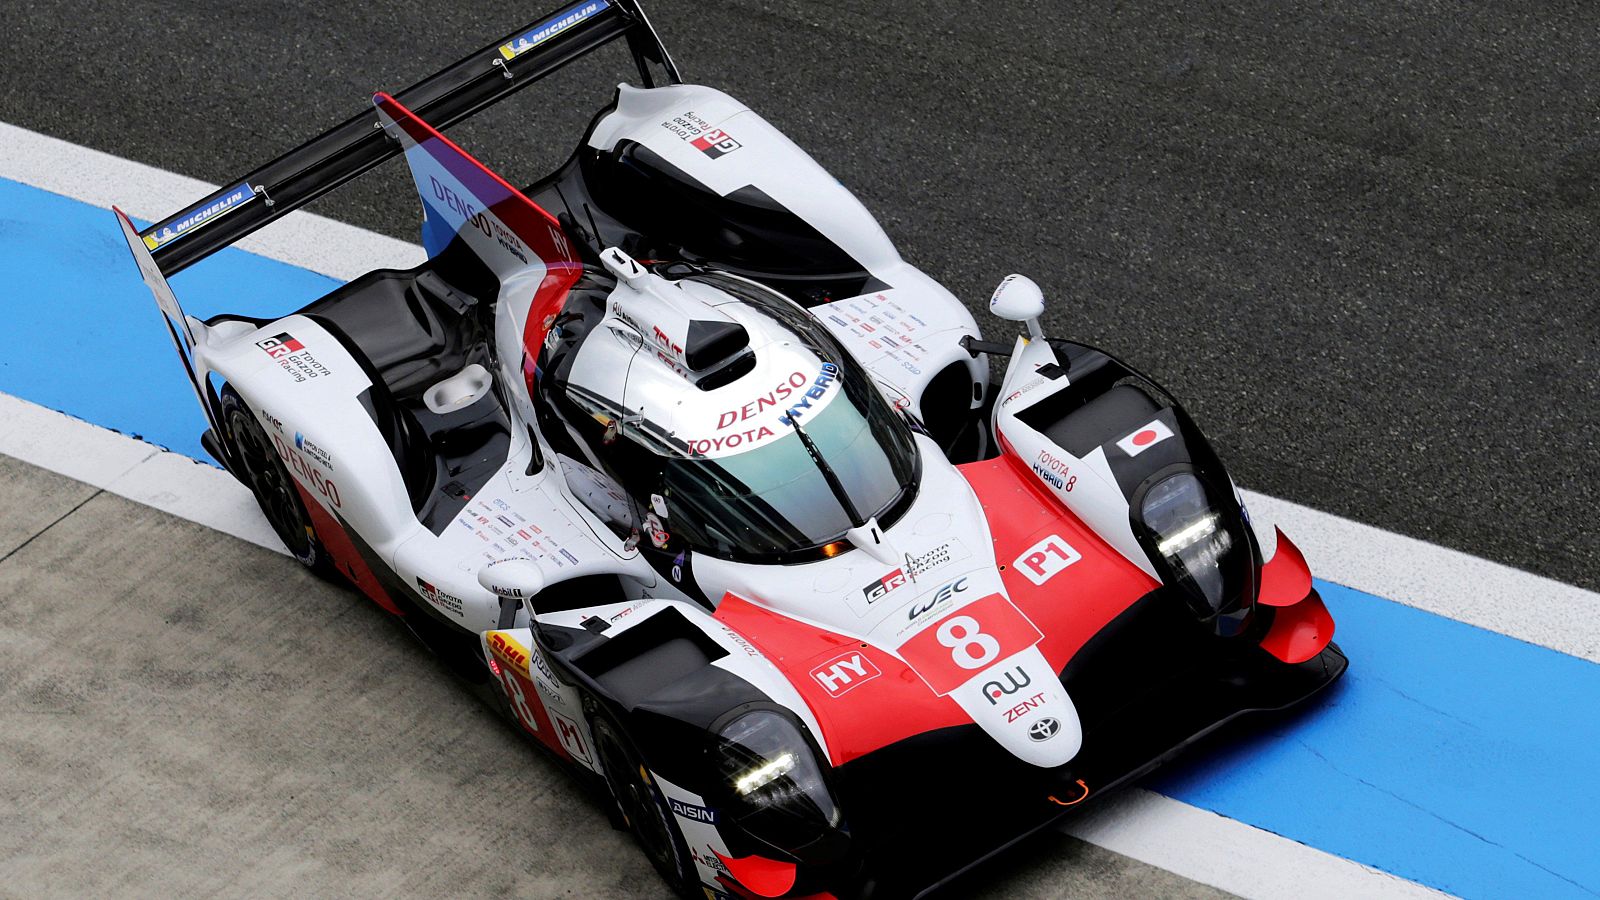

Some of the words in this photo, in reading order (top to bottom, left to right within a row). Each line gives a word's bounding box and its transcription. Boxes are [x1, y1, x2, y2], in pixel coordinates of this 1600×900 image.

[532, 3, 597, 42] MICHELIN
[661, 121, 691, 141] TOYOTA
[177, 191, 242, 232] MICHELIN
[430, 175, 492, 238] DENSO
[278, 359, 306, 383] Racing
[288, 355, 318, 379] GAZOO
[300, 350, 331, 377] TOYOTA
[687, 425, 775, 455] TOYOTA
[777, 361, 840, 427] HYBRID
[716, 371, 807, 430] DENSO
[272, 432, 341, 508] DENSO
[1032, 461, 1064, 490] HYBRID
[1065, 475, 1077, 493] 8
[1037, 449, 1070, 478] TOYOTA
[1023, 542, 1070, 577] P1
[866, 567, 908, 603] GR
[909, 577, 969, 621] WEC
[491, 633, 525, 672] DHL
[936, 615, 1000, 670] 8
[816, 655, 867, 692] HY
[503, 668, 538, 732] 8
[1002, 692, 1046, 724] ZENT
[556, 716, 585, 755] P1
[674, 802, 714, 822] AISIN
